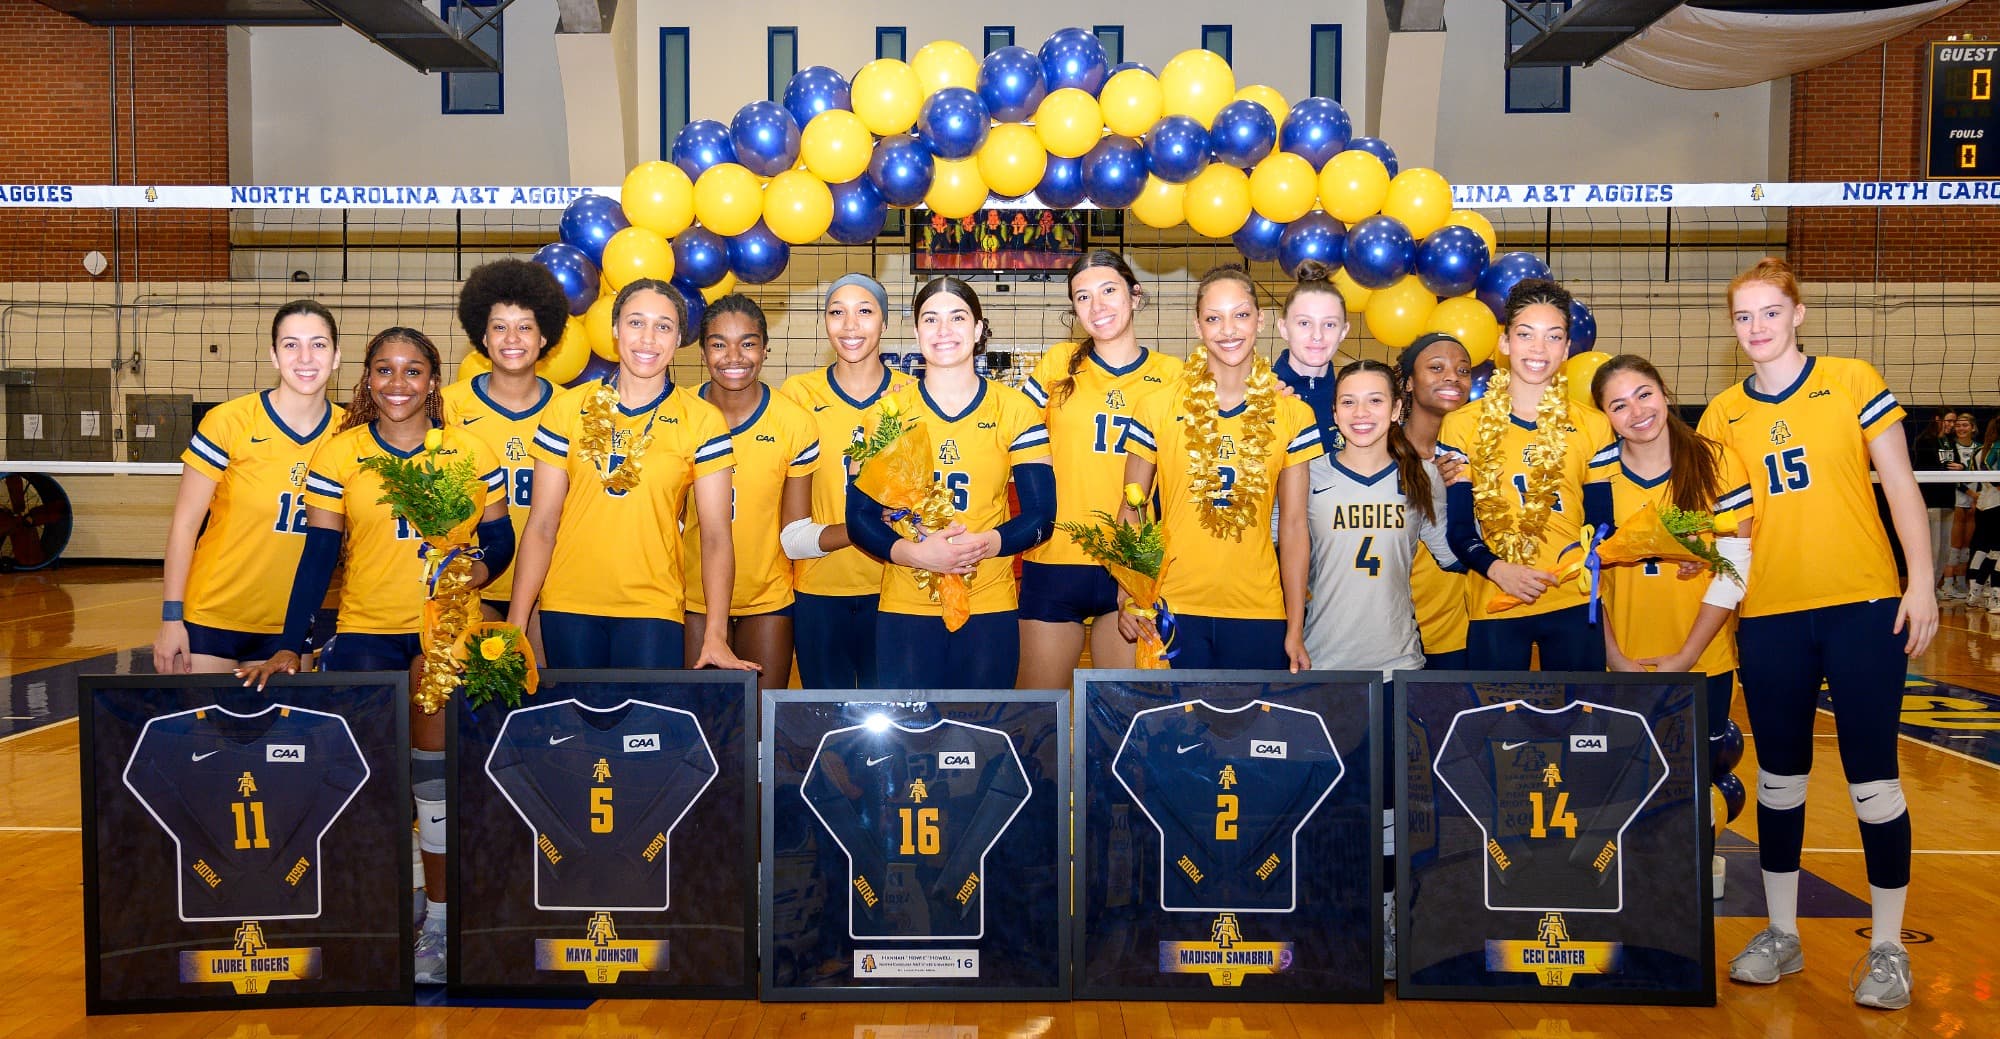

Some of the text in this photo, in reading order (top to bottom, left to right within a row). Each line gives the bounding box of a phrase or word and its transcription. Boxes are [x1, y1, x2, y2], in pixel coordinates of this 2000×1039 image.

[1940, 47, 1997, 62] GUEST
[1972, 68, 1992, 100] 0
[1949, 129, 1984, 139] FOULS
[1961, 144, 1977, 168] 0
[231, 186, 310, 204] NORTH
[320, 187, 441, 204] CAROLINA
[451, 187, 500, 204] A&T
[1523, 184, 1576, 203] A&T
[1585, 184, 1674, 203] AGGIES
[1843, 182, 1928, 200] NORTH
[1143, 375, 1163, 383] CAA
[1808, 389, 1831, 398] CAA
[658, 415, 679, 424] CAA
[977, 421, 997, 429] CAA
[755, 434, 776, 443] CAA
[1094, 412, 1132, 455] 17
[1764, 446, 1811, 496] 15
[1333, 504, 1405, 530] AGGIES
[1355, 535, 1381, 577] 4
[628, 738, 655, 748] CAA
[1255, 743, 1282, 755] CAA
[1575, 738, 1602, 749] CAA
[271, 748, 299, 760] CAA
[944, 755, 971, 766] CAA
[591, 787, 614, 833] 5
[1215, 794, 1239, 840] 2
[1529, 792, 1578, 838] 14
[231, 802, 270, 849] 11
[899, 807, 941, 855] 16
[538, 833, 563, 865] PRIDE
[642, 832, 667, 862] AGGIE
[1487, 838, 1512, 871] PRIDE
[1592, 840, 1618, 873] AGGIE
[193, 858, 222, 888] PRIDE
[284, 856, 310, 886] AGGIE
[1177, 854, 1205, 884] PRIDE
[1255, 852, 1281, 881] AGGIE
[852, 875, 879, 908] PRIDE
[956, 872, 981, 905] AGGIE
[565, 947, 639, 963] MAYA JOHNSON
[957, 958, 974, 969] 16
[1180, 950, 1274, 966] MADISON SANABRIA
[1522, 948, 1585, 965] CECI CARTER
[211, 956, 290, 974] LAUREL ROGERS
[597, 967, 608, 983] 5
[1222, 970, 1232, 986] 2
[1546, 970, 1563, 986] 14
[245, 978, 258, 994] 11
